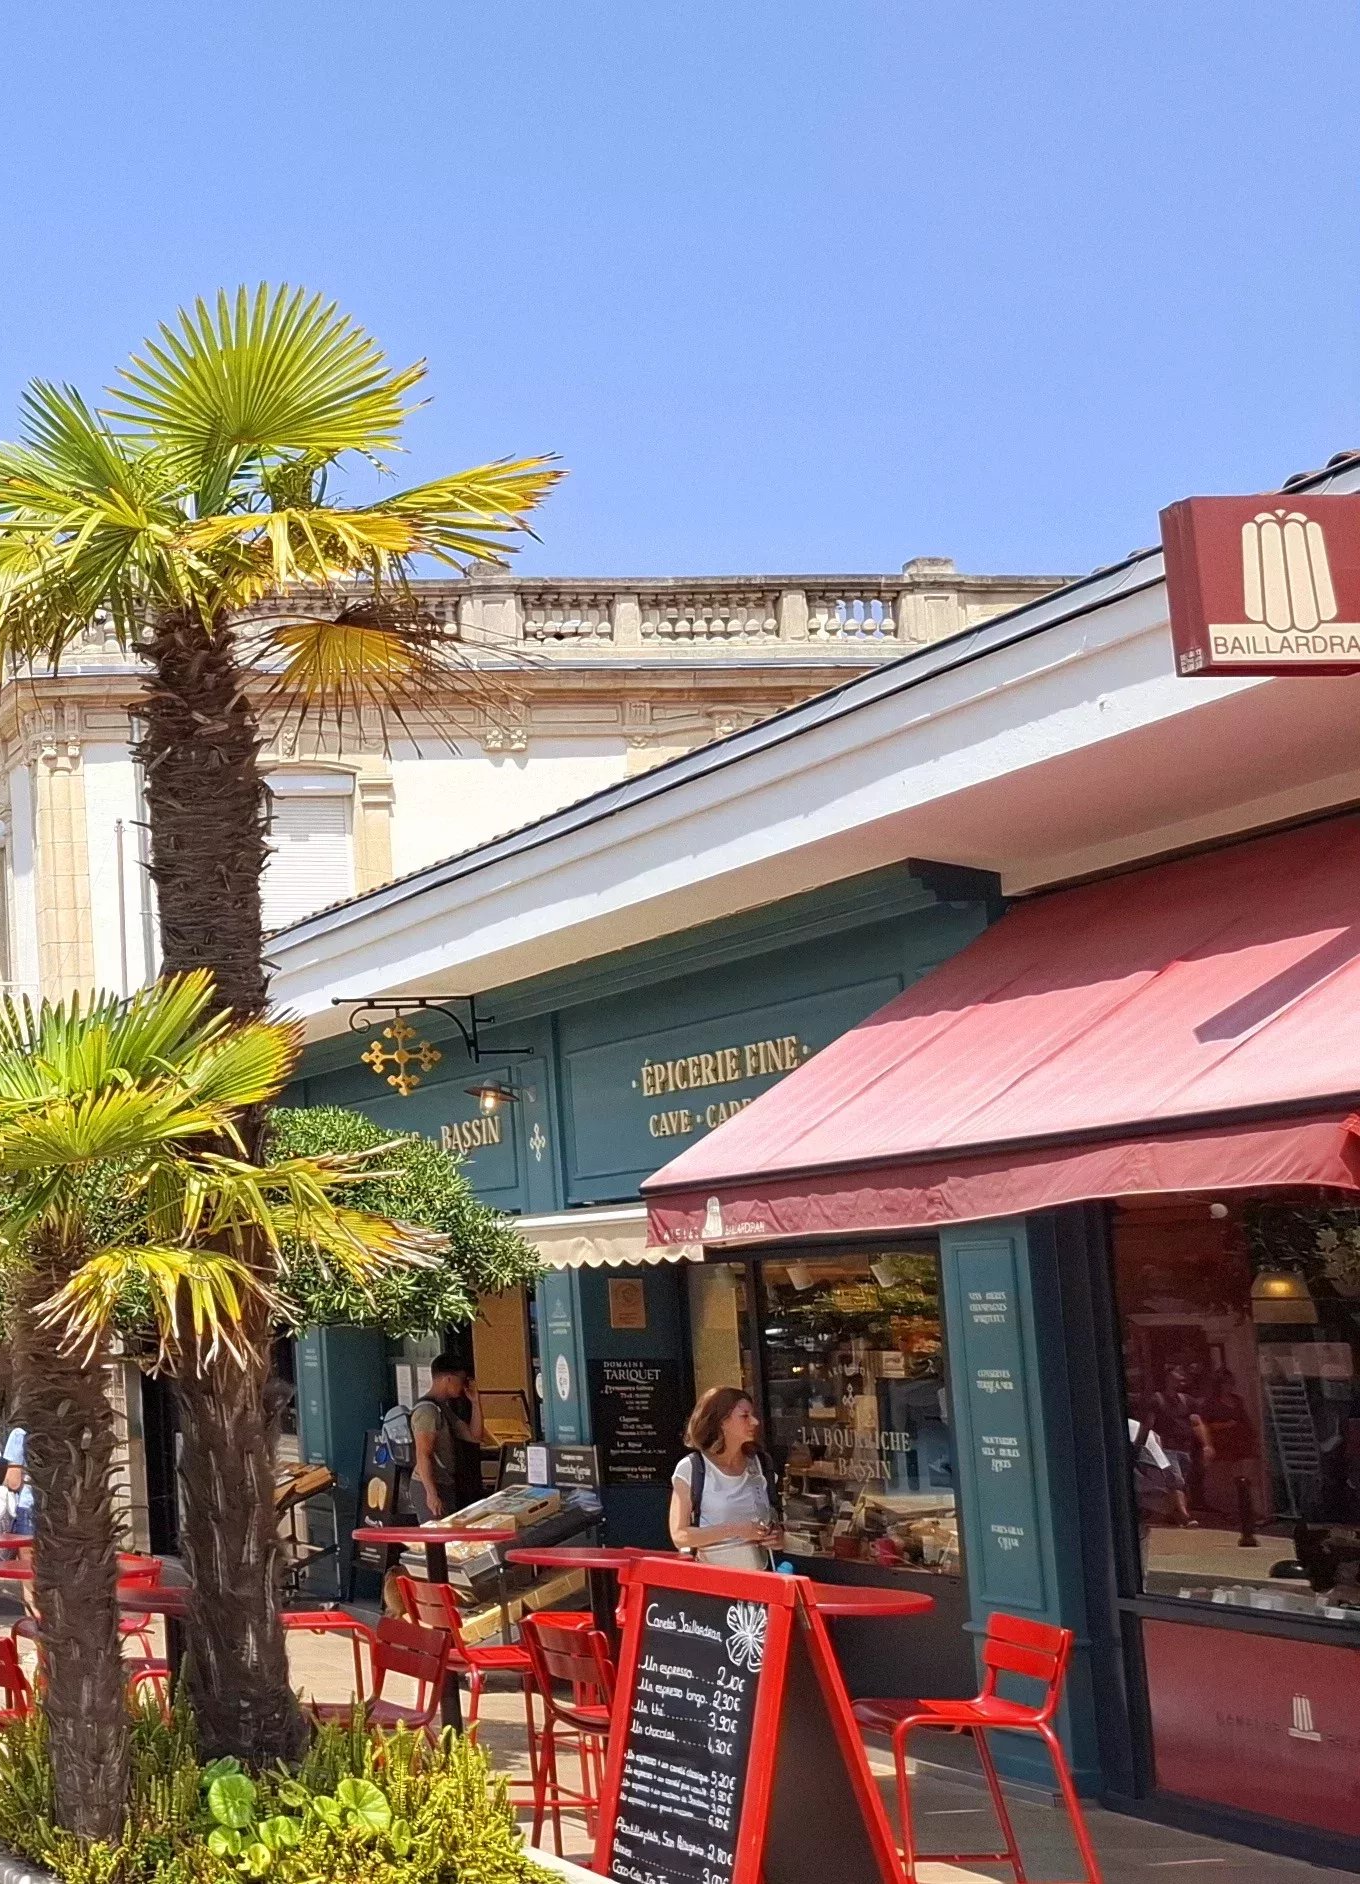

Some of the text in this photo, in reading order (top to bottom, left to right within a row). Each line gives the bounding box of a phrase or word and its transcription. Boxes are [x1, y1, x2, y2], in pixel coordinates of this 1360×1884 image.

[641, 1035, 798, 1096] ÉPICERIE FINE
[440, 1115, 499, 1155] BASSIN
[649, 1109, 691, 1138] CAVE
[603, 1369, 661, 1384] TARIQUET
[712, 1690, 741, 1712] 2,30€
[707, 1711, 738, 1734] 3,90€
